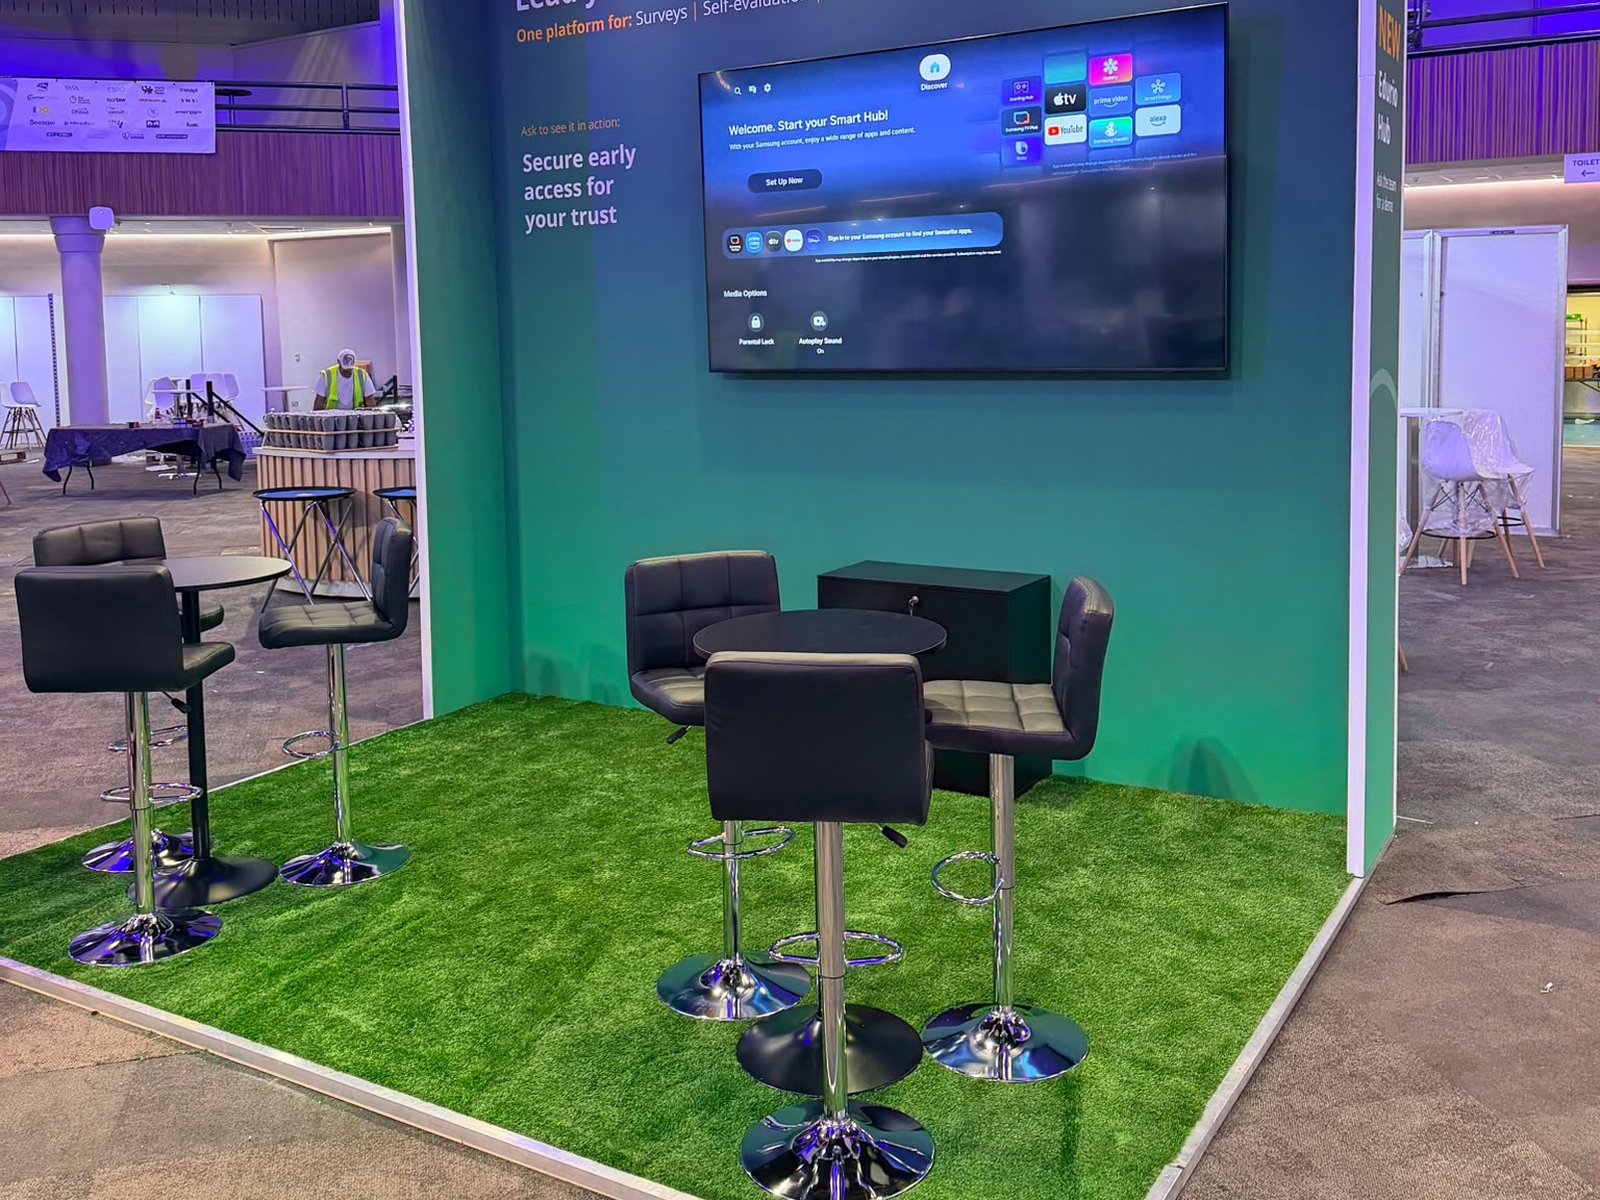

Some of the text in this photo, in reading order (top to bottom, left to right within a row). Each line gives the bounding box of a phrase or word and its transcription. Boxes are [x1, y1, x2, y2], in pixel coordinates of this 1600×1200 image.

[516, 28, 543, 43] One
[546, 19, 605, 43] platform
[608, 14, 633, 30] for:
[636, 6, 688, 26] Surveys
[1378, 4, 1401, 62] NEW
[920, 82, 949, 91] Discover
[520, 117, 621, 137] Ask to see it in action:
[728, 109, 889, 136] Welcome. Start your Smart Hub!
[1060, 125, 1083, 135] YouTube
[1377, 112, 1392, 145] Hub
[743, 142, 754, 150] your
[755, 140, 780, 148] Samsung
[805, 136, 820, 144] enjoy
[825, 134, 839, 142] wide
[522, 143, 637, 173] Secure early
[524, 175, 615, 201] access for
[765, 176, 804, 187] Set Up Now
[524, 205, 618, 235] your trust
[922, 229, 934, 237] your
[723, 289, 767, 299] Media Options
[798, 337, 843, 345] Autoplay Sound
